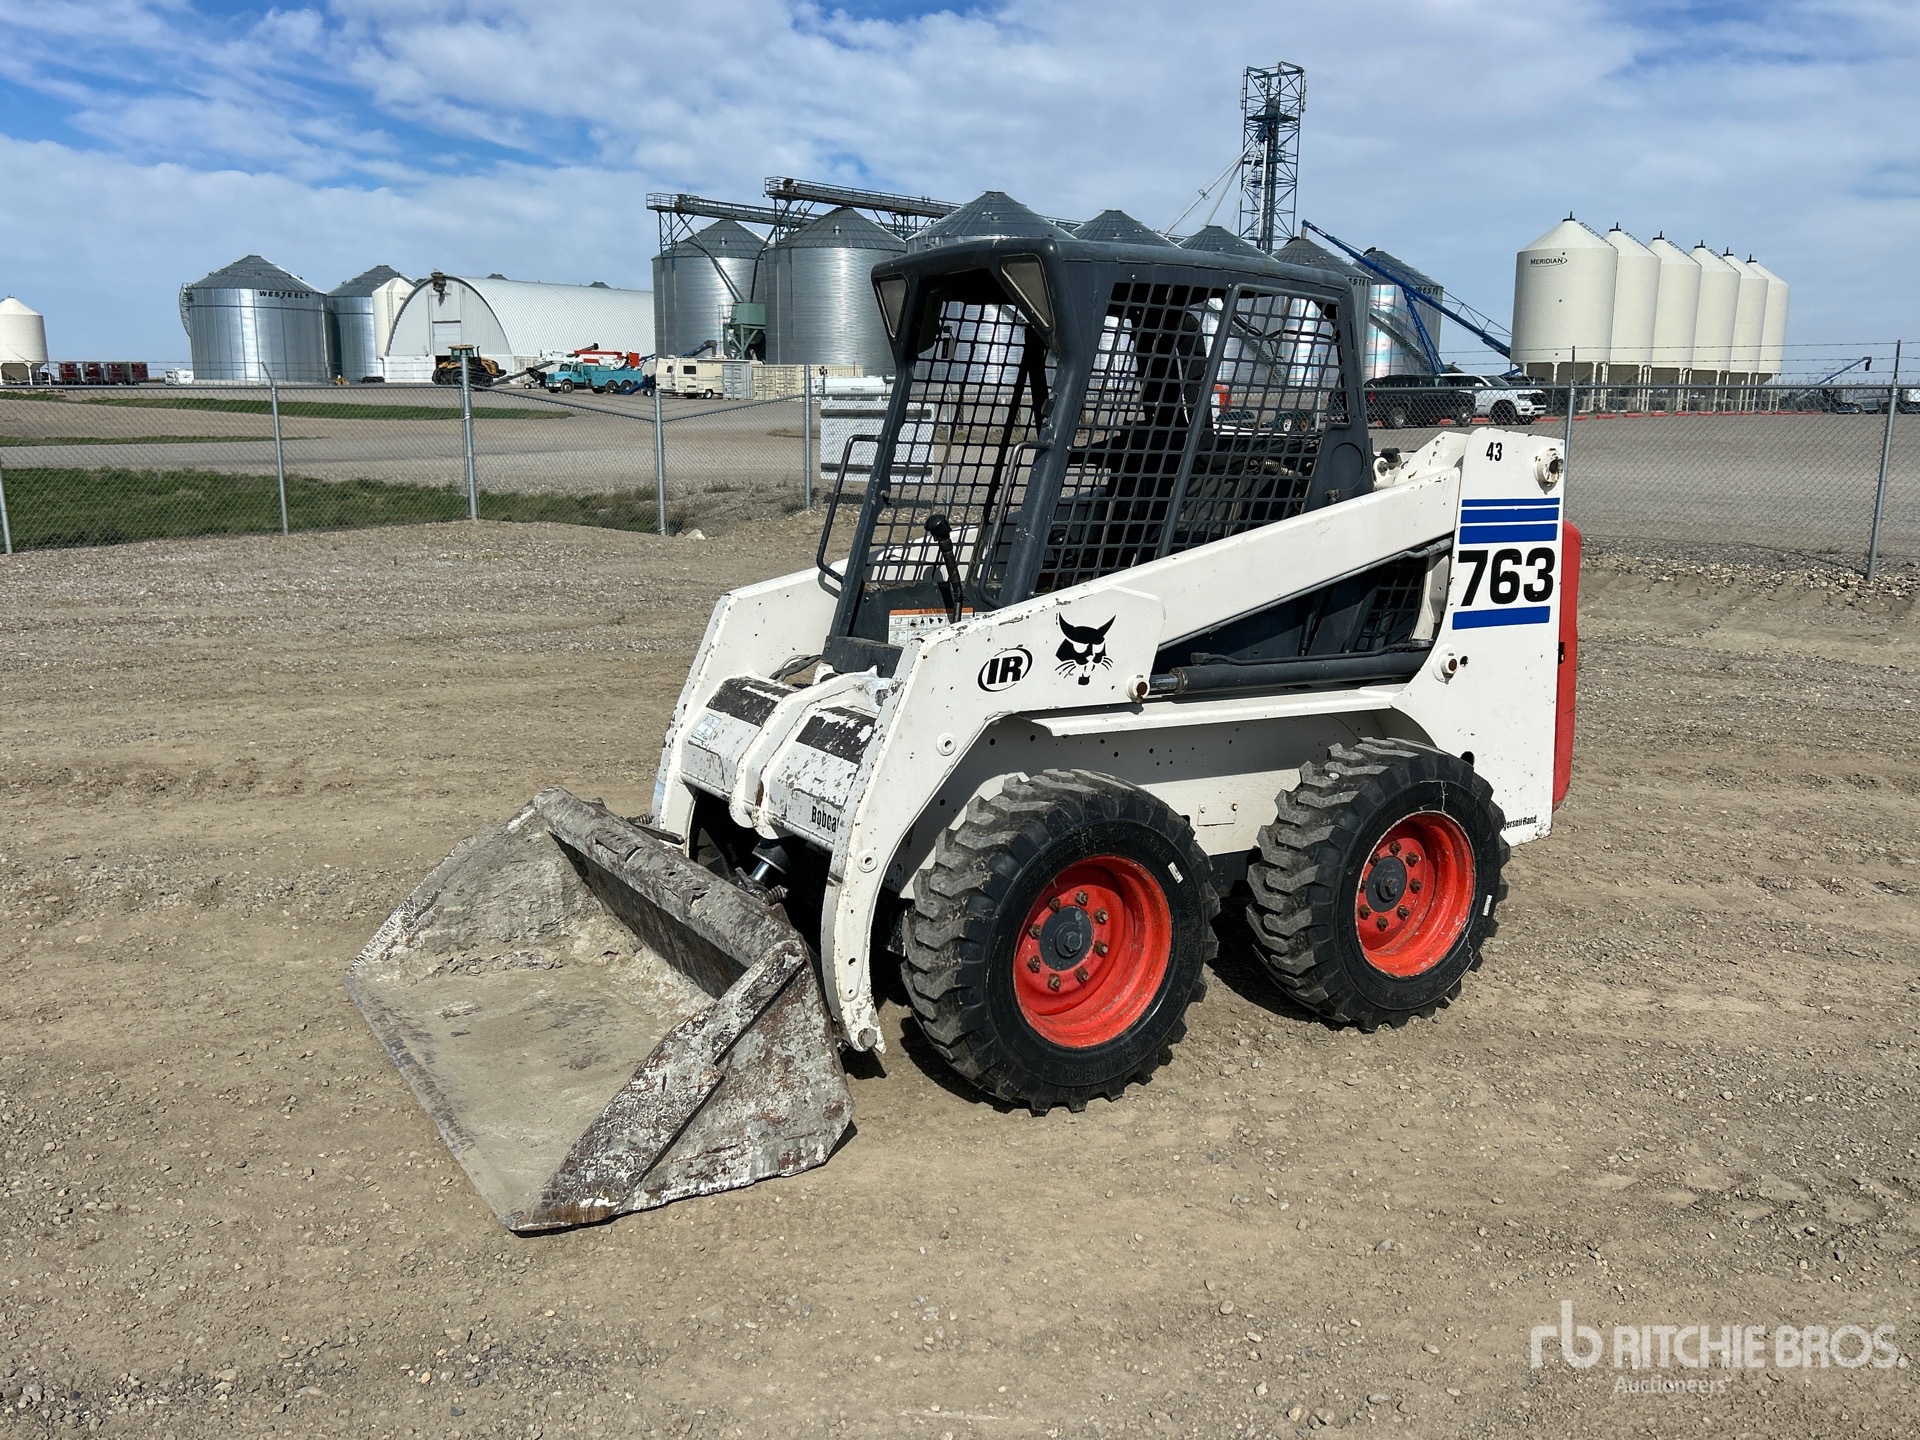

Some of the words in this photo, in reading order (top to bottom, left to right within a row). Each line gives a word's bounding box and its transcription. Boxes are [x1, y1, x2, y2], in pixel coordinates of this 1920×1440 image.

[1530, 257, 1563, 265] MERIDIAN
[260, 290, 304, 299] WESTEEL
[1486, 441, 1503, 462] 43
[1458, 547, 1556, 607] 763
[986, 655, 1024, 685] IR
